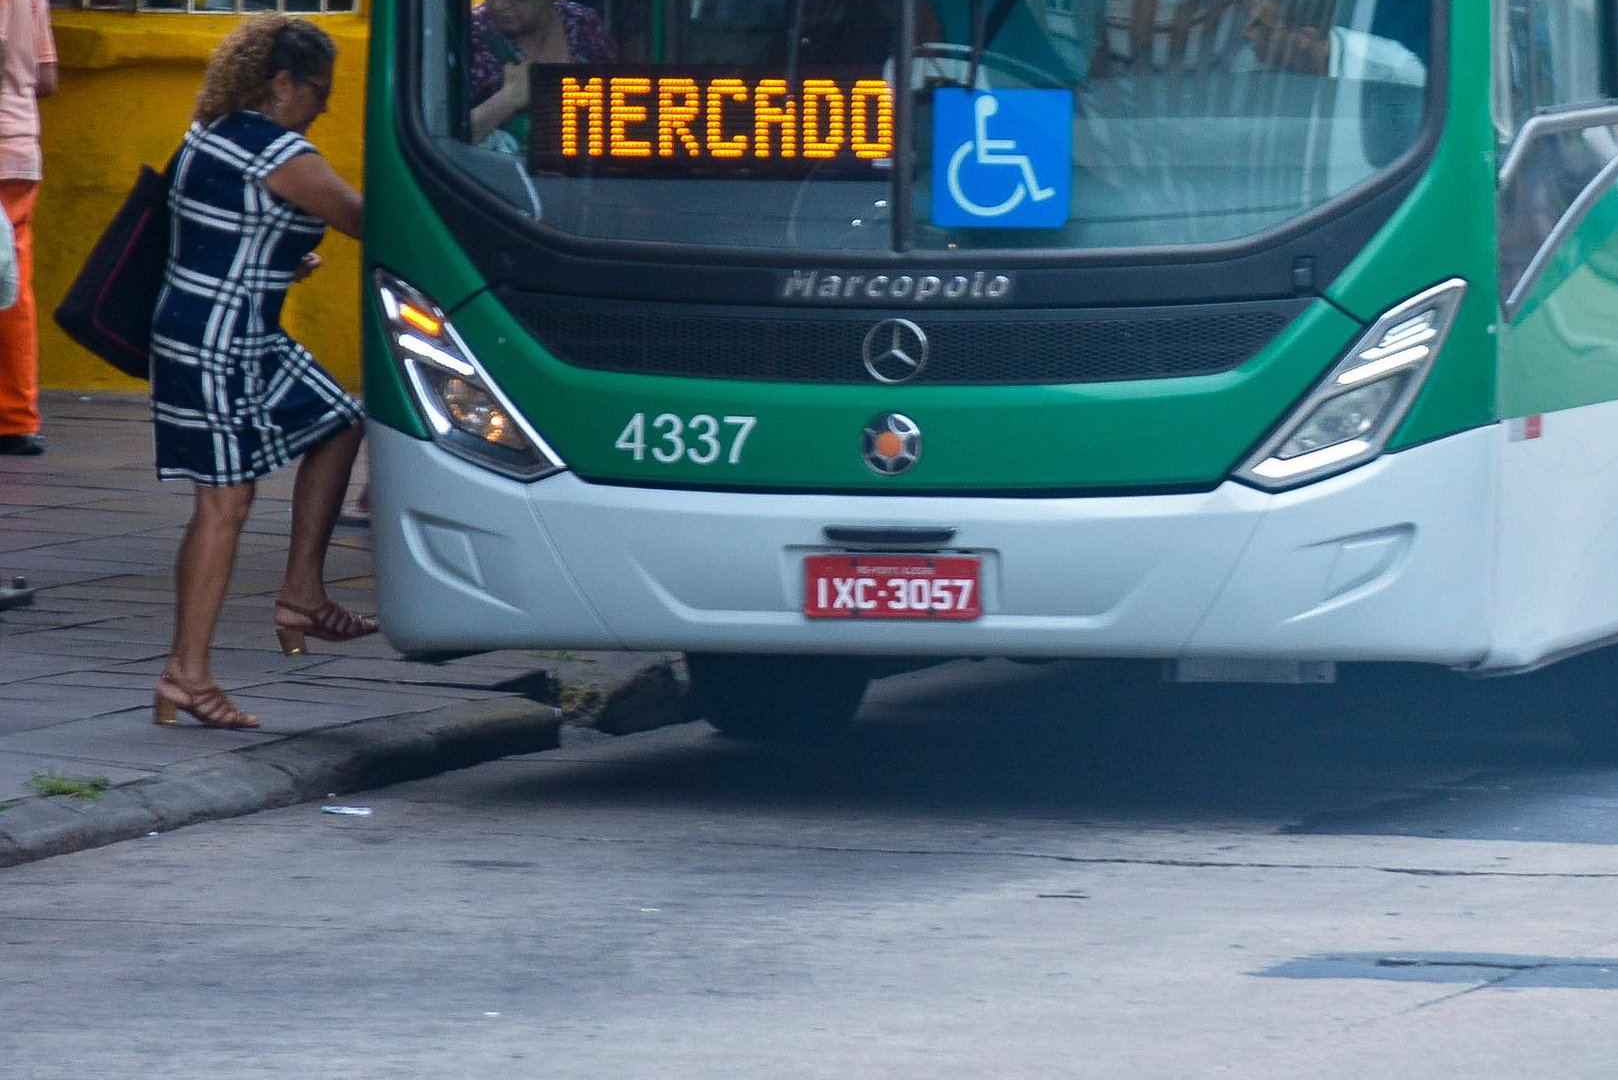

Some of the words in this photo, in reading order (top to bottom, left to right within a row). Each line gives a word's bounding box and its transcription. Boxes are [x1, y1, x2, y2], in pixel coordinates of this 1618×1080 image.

[561, 77, 894, 159] MERCADO
[783, 270, 1010, 300] Marcopolo
[614, 412, 758, 464] 4337
[817, 577, 974, 610] IXC-3057
